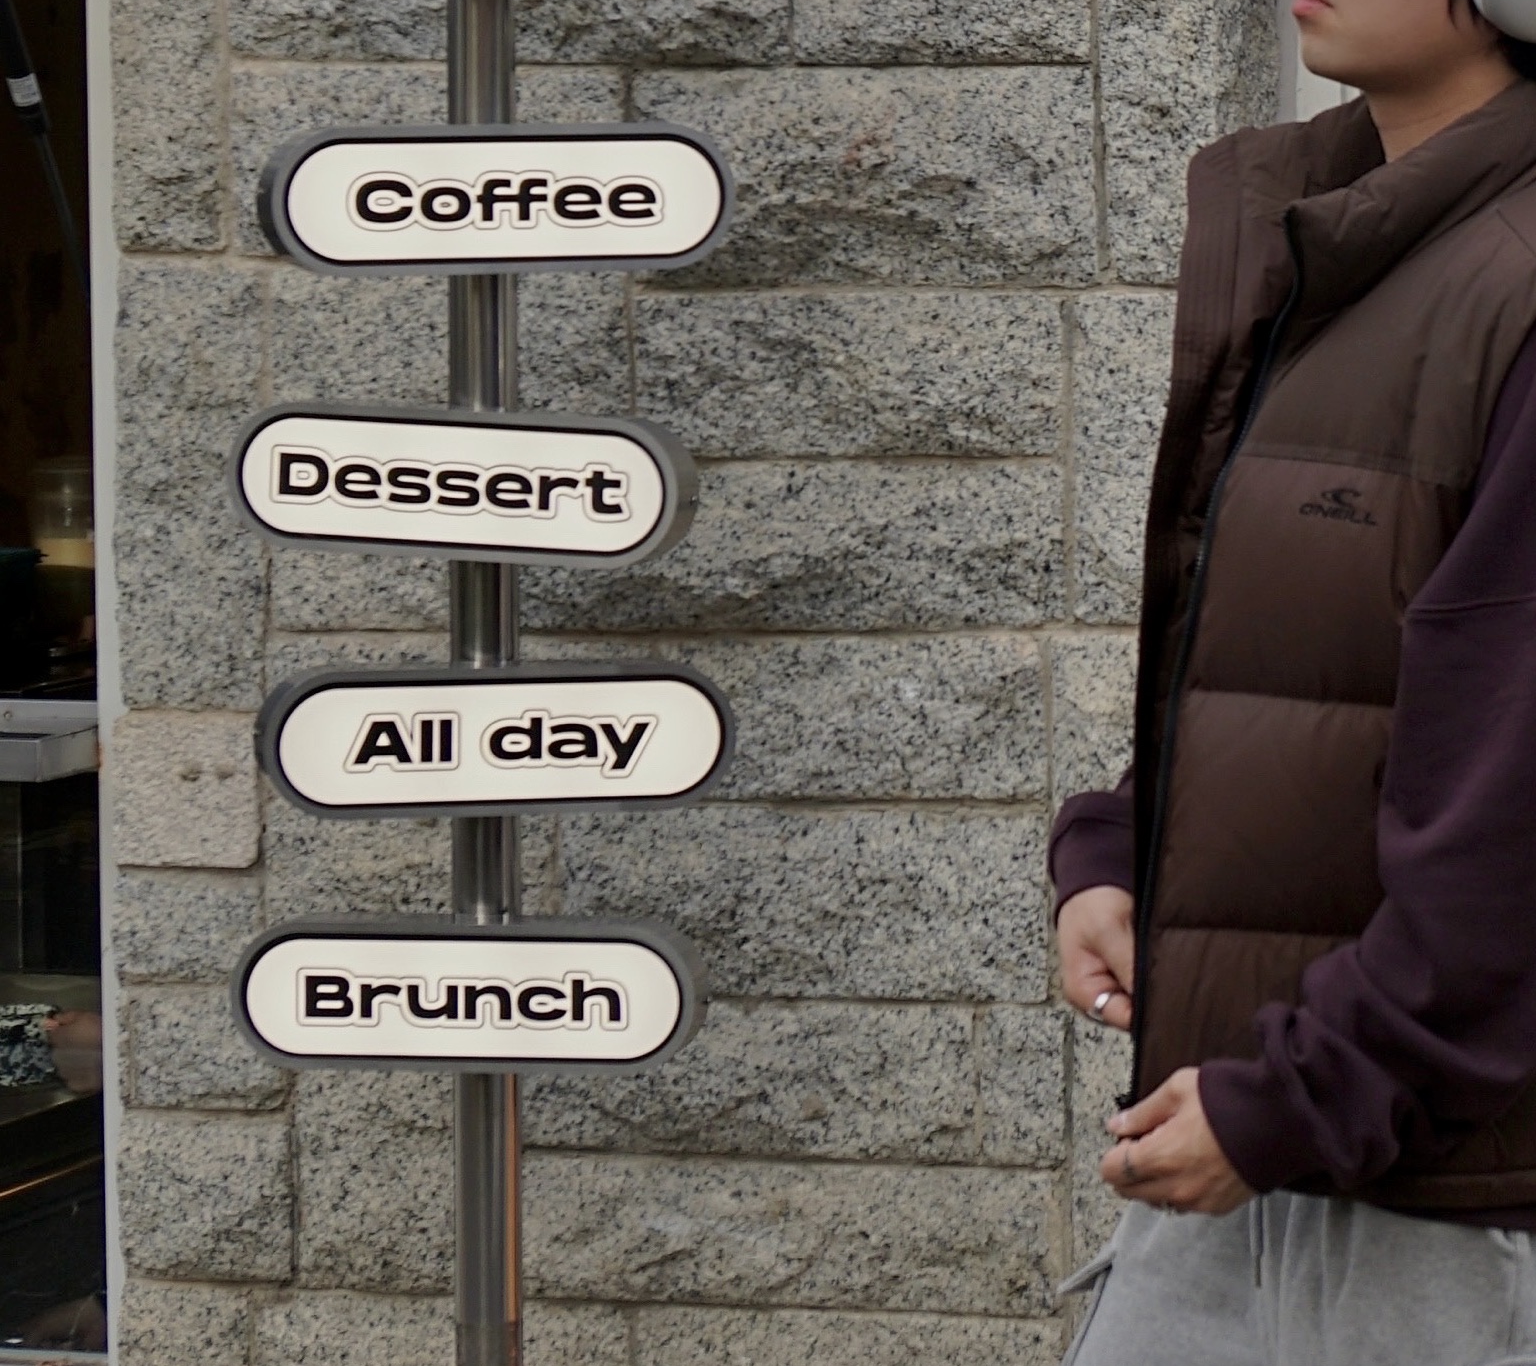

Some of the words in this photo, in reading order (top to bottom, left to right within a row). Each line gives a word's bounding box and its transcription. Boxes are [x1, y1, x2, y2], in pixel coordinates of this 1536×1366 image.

[355, 178, 657, 225] Coffee
[278, 452, 626, 516] Dessert
[354, 719, 454, 766] All
[489, 717, 652, 772] day
[305, 975, 623, 1023] Brunch
